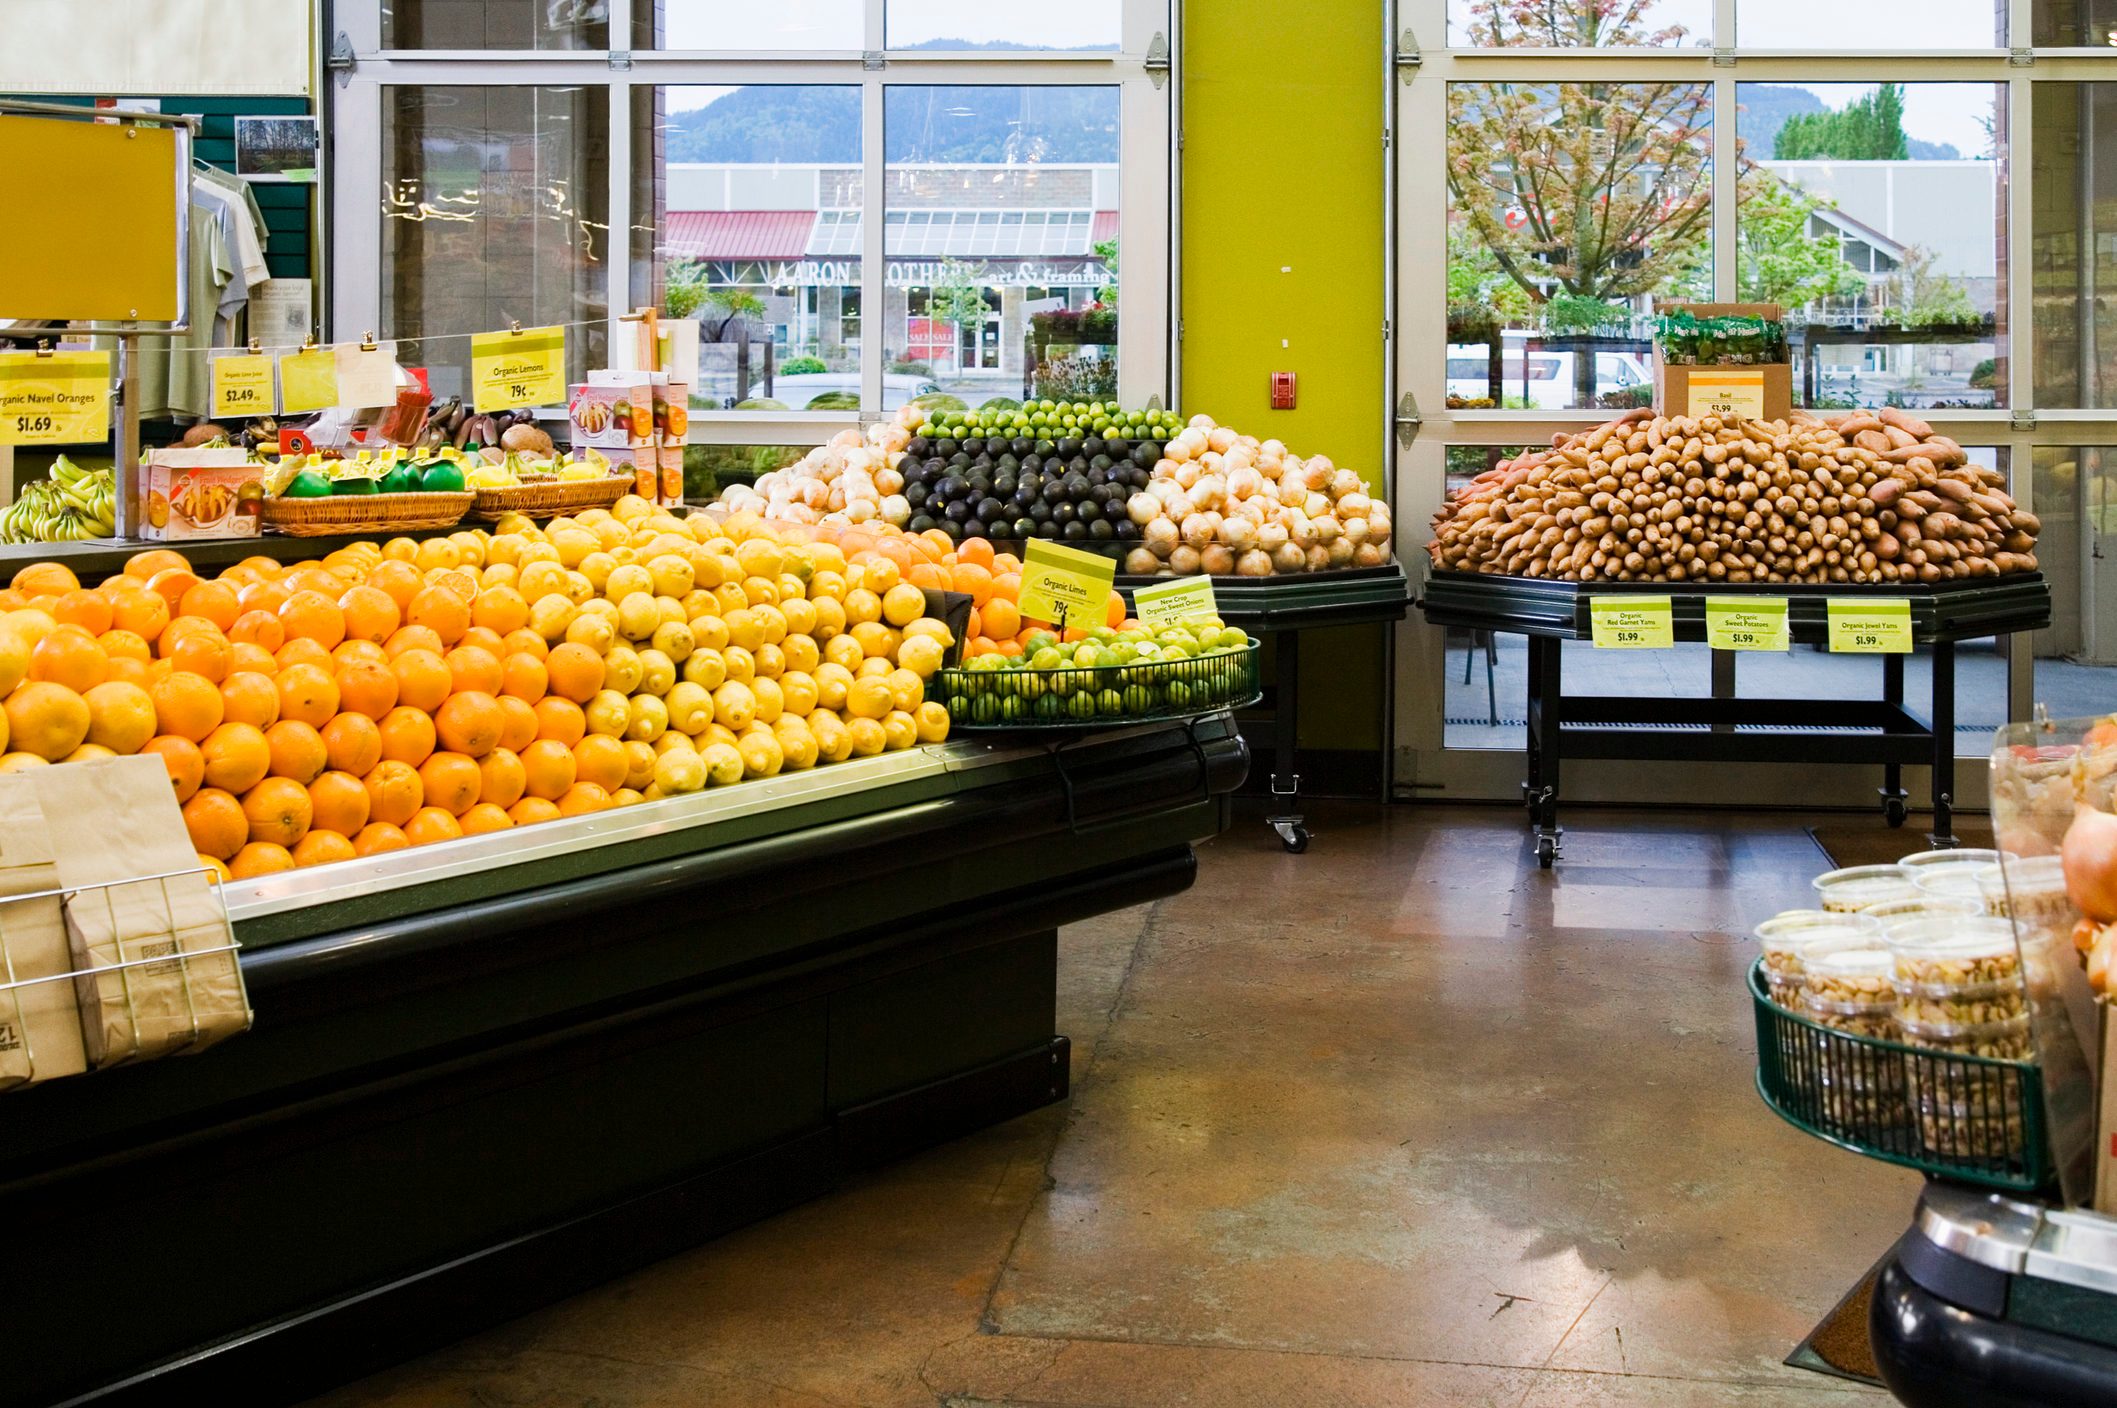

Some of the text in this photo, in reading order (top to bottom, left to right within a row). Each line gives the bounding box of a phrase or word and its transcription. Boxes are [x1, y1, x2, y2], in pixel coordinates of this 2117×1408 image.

[777, 261, 851, 287] AARON
[988, 270, 1013, 283] art
[1016, 261, 1038, 286] &
[1042, 267, 1110, 286] framing
[493, 364, 544, 377] Organic Lemons
[226, 389, 254, 402] $2.49
[511, 385, 526, 398] 79¢
[0, 393, 95, 407] rganic Navel Oranges
[17, 416, 51, 433] $1.69
[1043, 577, 1068, 591] Organic
[1068, 583, 1087, 596] Limes
[1053, 600, 1069, 615] 79¢
[1146, 606, 1167, 615] Organic
[1185, 598, 1204, 606] Onions
[1725, 619, 1769, 628] Sweet Potatoes
[1841, 622, 1864, 630] Organic
[1617, 632, 1638, 642] $1.99
[1732, 633, 1754, 643] $1.99
[1855, 635, 1877, 645] $1.99
